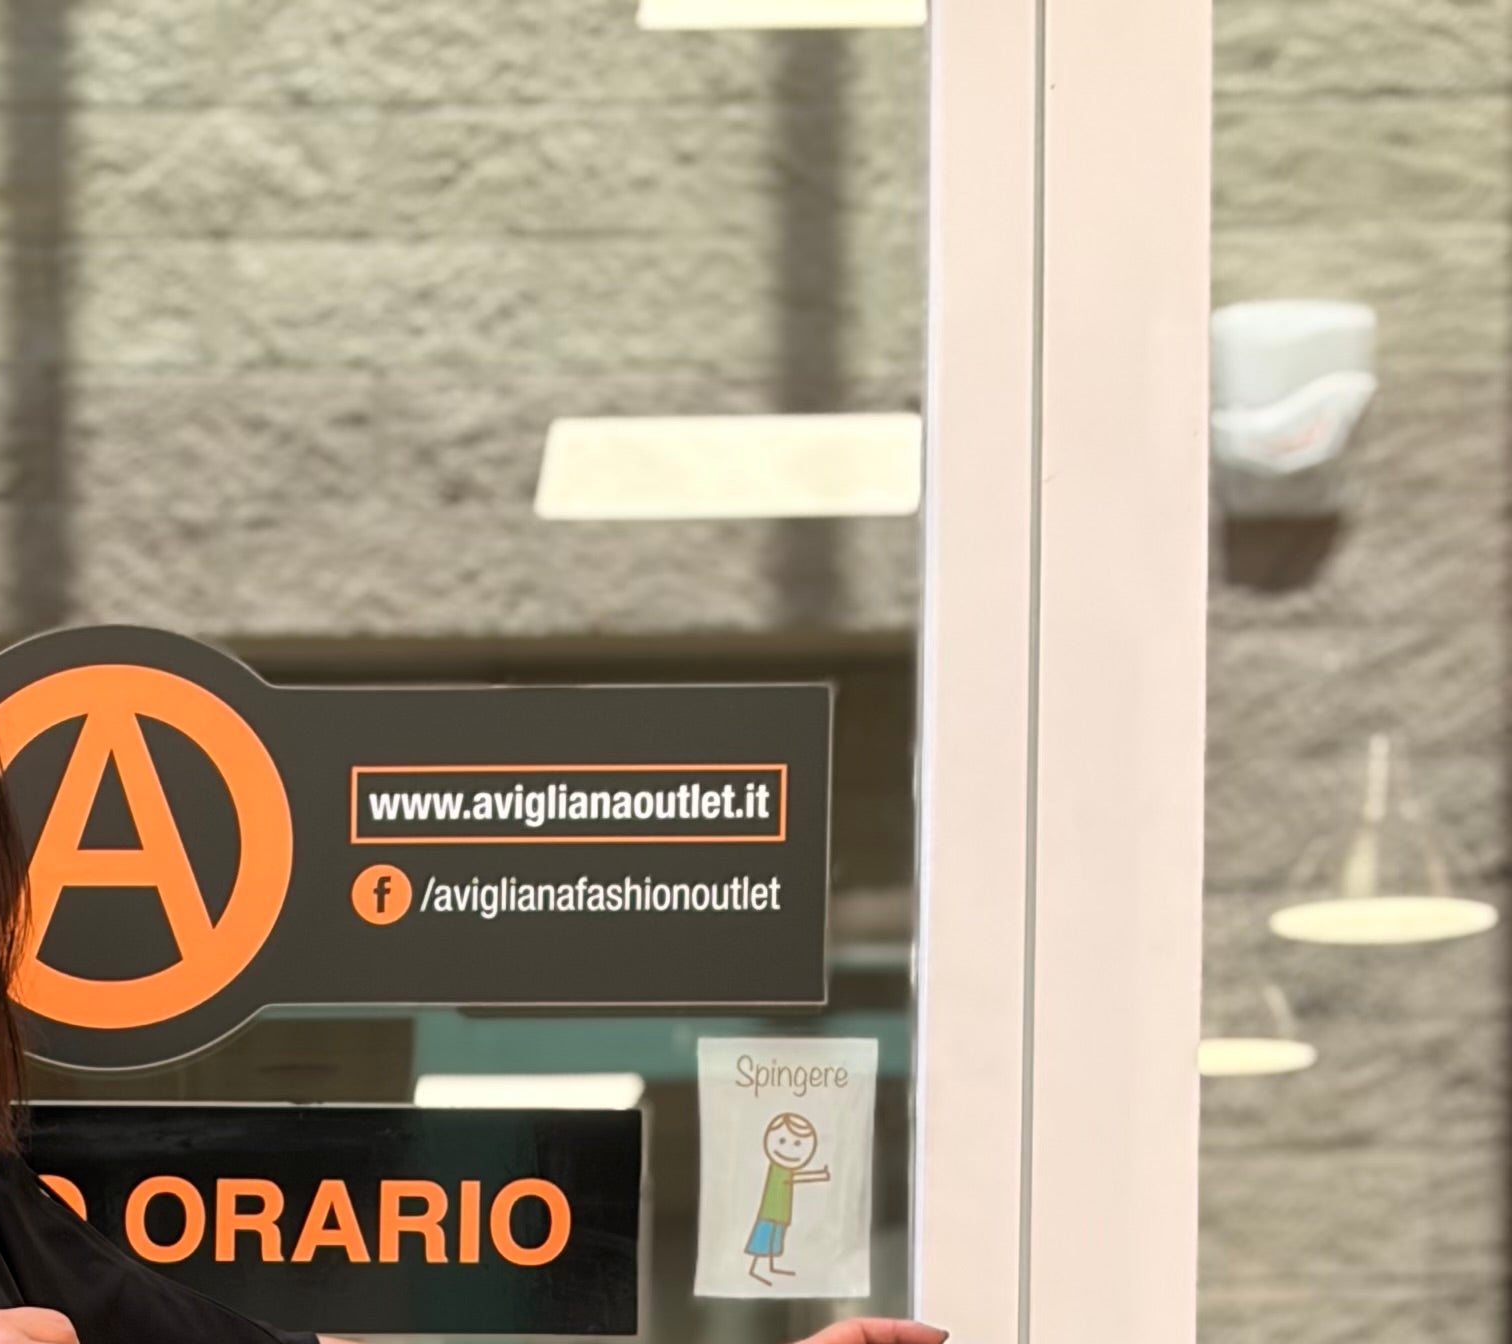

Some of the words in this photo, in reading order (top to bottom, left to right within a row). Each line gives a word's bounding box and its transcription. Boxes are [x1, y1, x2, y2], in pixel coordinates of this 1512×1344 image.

[369, 783, 769, 826] www.aviglianaoutlet.it
[420, 876, 781, 919] /aviglianafashionoutlet
[736, 1054, 848, 1098] Spingere
[125, 1175, 572, 1266] ORARIO
